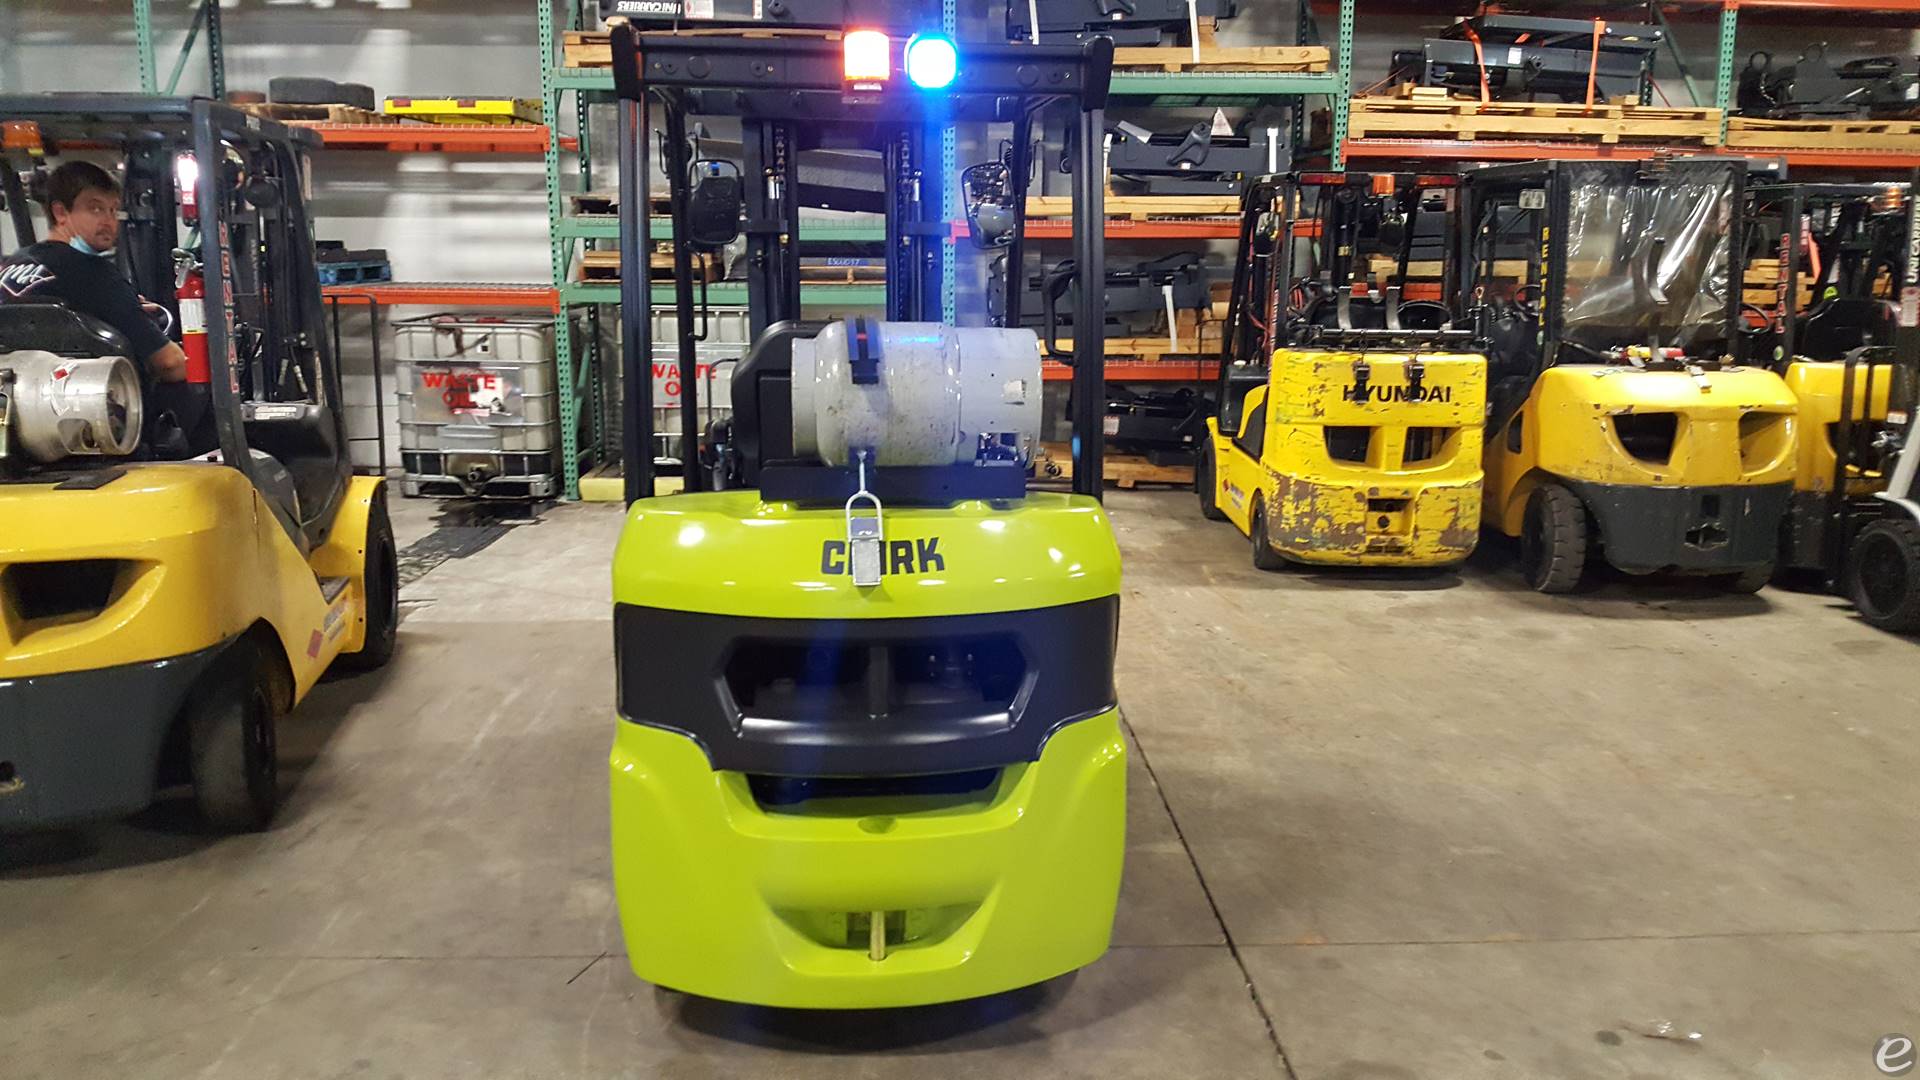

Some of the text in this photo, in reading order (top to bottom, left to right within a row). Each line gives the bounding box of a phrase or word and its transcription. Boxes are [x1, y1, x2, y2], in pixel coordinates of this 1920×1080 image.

[219, 220, 239, 393] RENTAL
[1538, 226, 1550, 327] RENTAL
[1775, 233, 1790, 334] RENTAL
[821, 537, 945, 575] CRK
